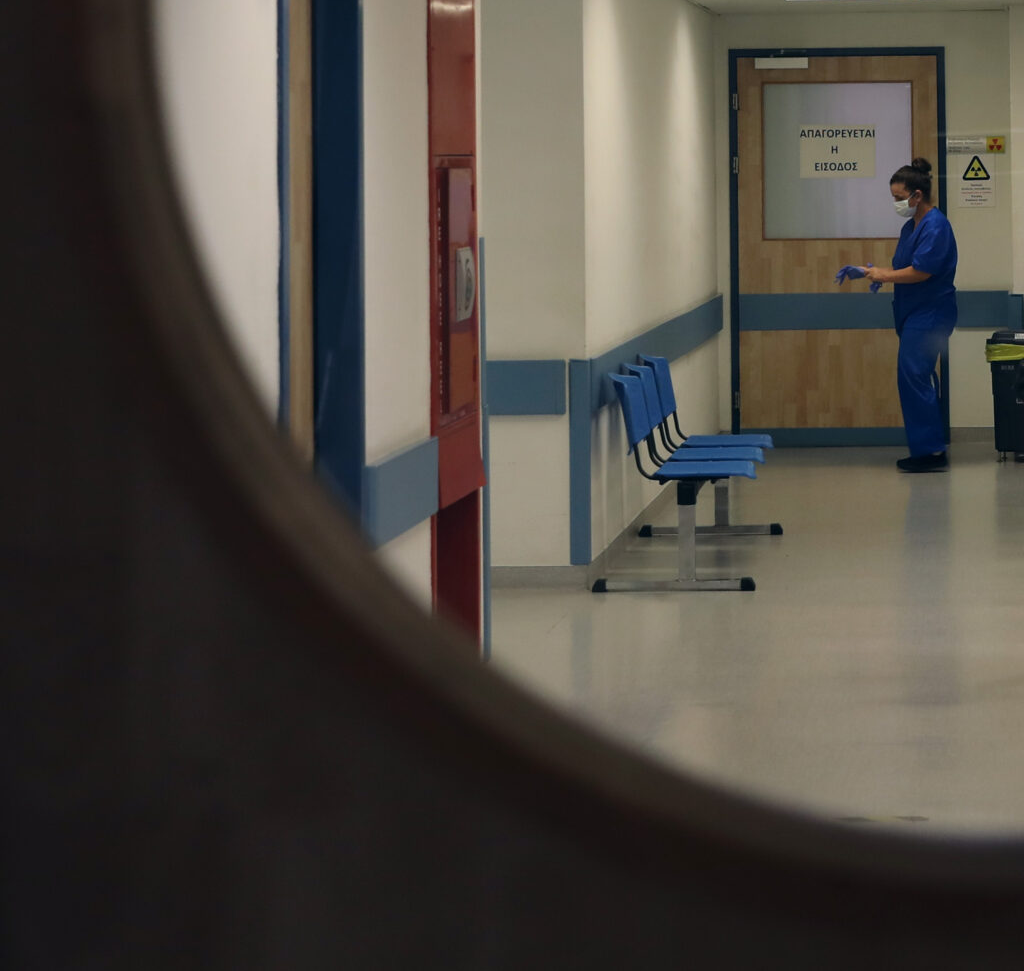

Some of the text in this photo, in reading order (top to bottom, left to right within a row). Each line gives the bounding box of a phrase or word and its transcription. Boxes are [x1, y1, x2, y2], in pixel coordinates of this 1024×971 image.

[800, 129, 875, 139] ΑΠΑΓΟΡΕΥΕΤΑΙ
[831, 146, 838, 154] Η
[814, 162, 858, 171] ΕΙΣΟΔΟΣ
